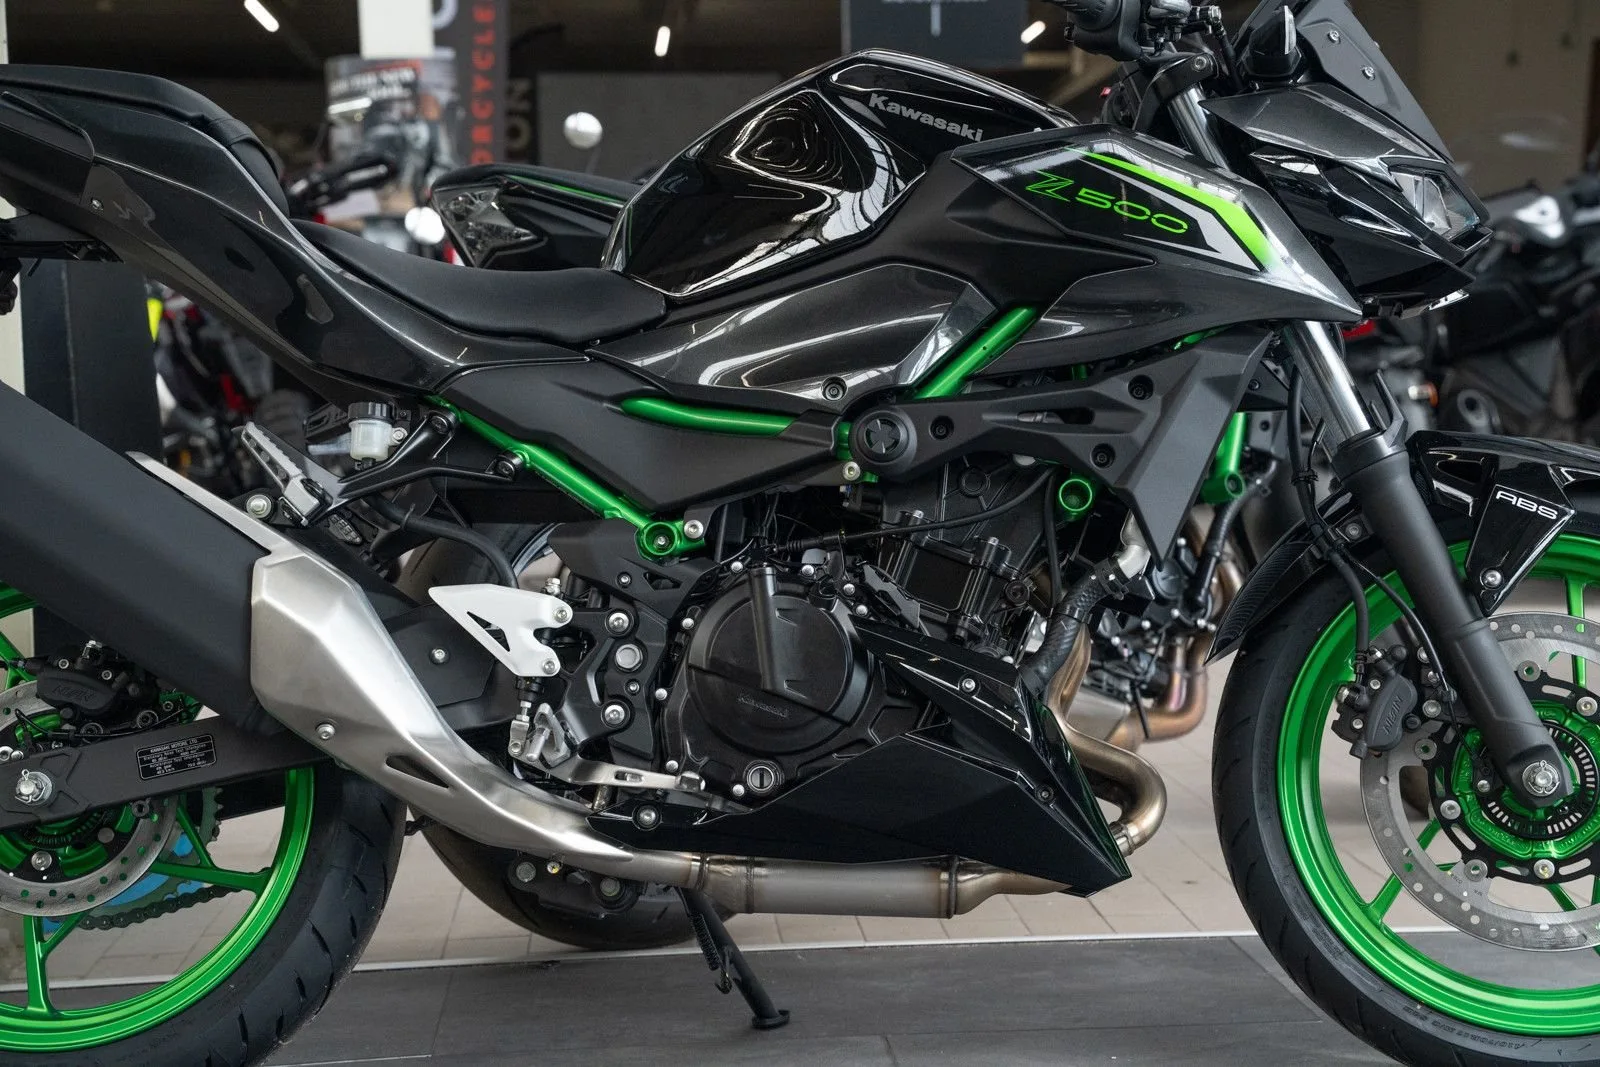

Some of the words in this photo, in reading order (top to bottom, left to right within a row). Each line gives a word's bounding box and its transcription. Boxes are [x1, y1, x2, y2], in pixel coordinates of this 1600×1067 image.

[868, 92, 984, 143] Kawasaki
[1025, 169, 1189, 234] Z500
[1495, 490, 1558, 520] ABS
